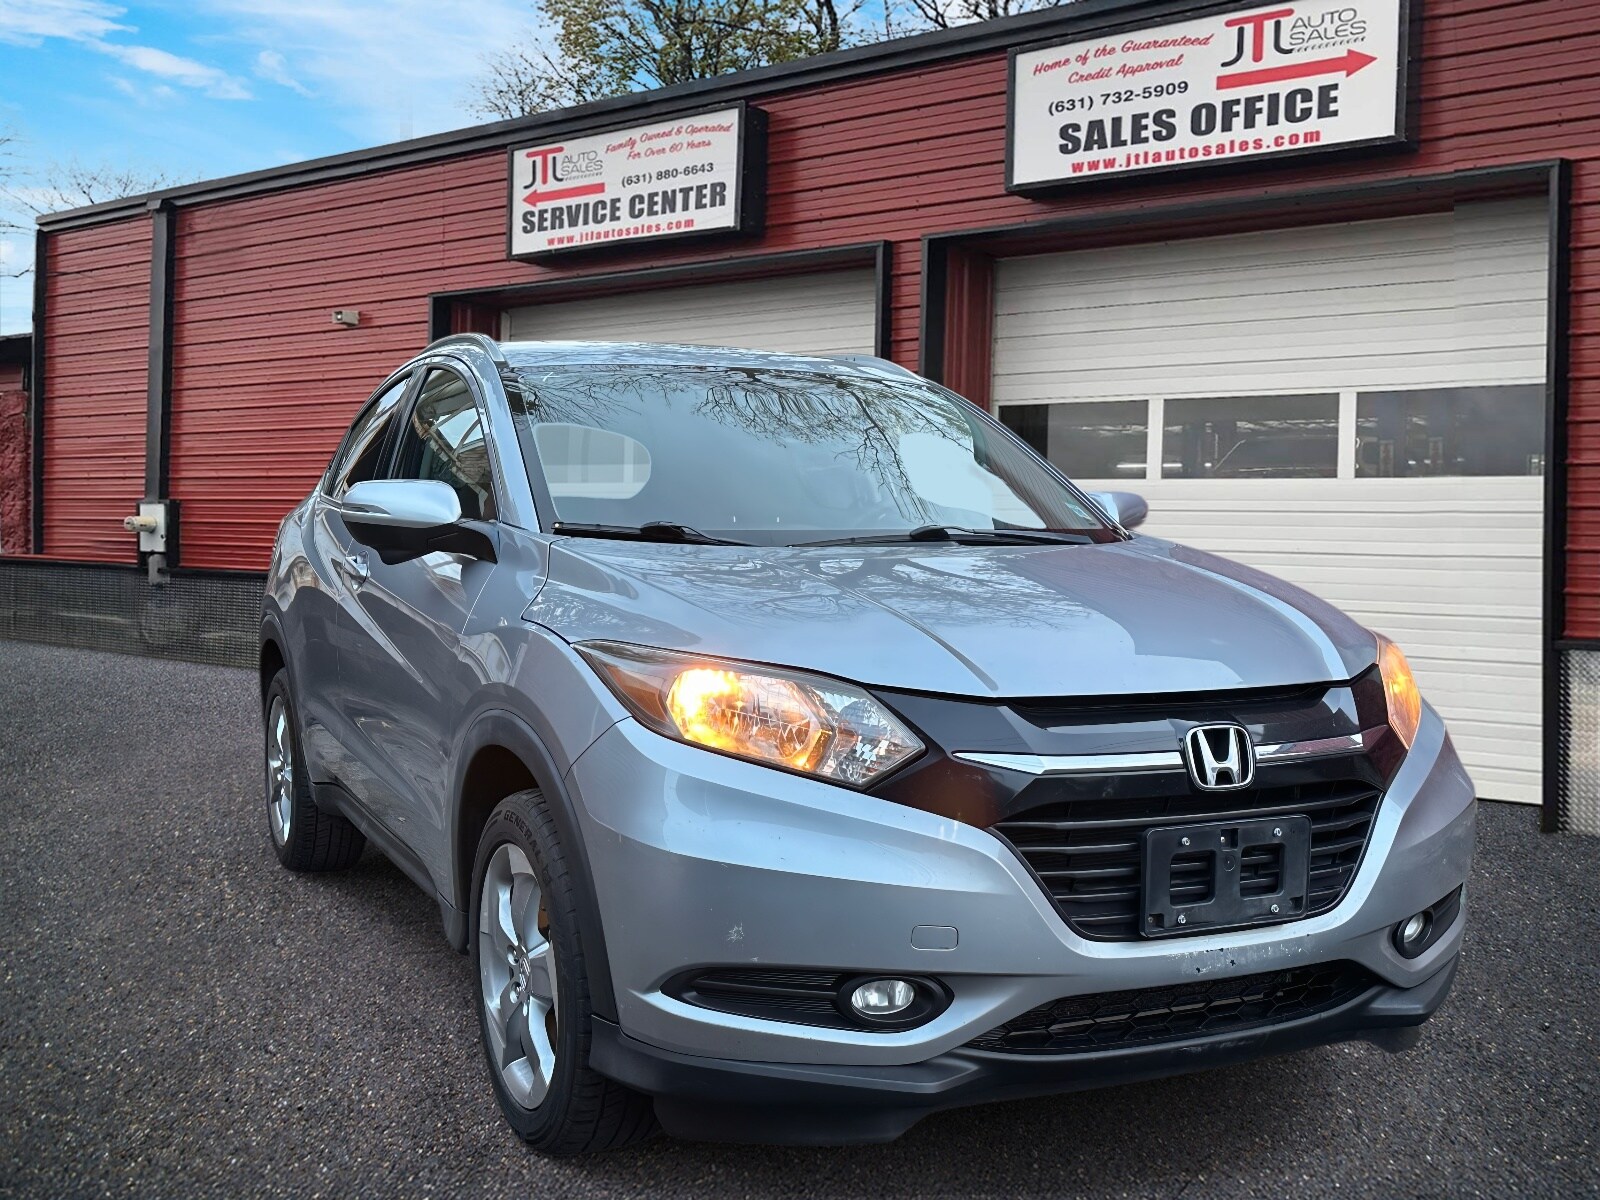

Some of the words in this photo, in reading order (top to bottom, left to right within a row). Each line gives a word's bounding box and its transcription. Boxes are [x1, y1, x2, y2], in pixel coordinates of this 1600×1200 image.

[1289, 20, 1367, 46] SALES
[1290, 7, 1358, 32] AUTO
[1033, 57, 1071, 76] Home
[1075, 49, 1090, 67] of
[1094, 45, 1117, 60] the
[1121, 33, 1214, 53] Guaranteed
[1067, 67, 1113, 85] Credit
[1116, 54, 1183, 79] Approval
[1047, 96, 1094, 117] (631)
[1100, 80, 1189, 106] 732-5909
[1058, 108, 1177, 155] SALES
[1190, 83, 1339, 137] OFFICE
[605, 138, 637, 154] Family
[640, 130, 673, 143] Owned
[675, 126, 683, 136] &
[685, 122, 734, 137] Operated
[627, 149, 641, 161] For
[644, 147, 667, 157] Over
[670, 142, 684, 153] 60
[686, 139, 712, 151] Years
[1071, 129, 1321, 174] www.jtlautosales.com
[560, 160, 604, 177] SALES
[561, 150, 598, 166] AUTO
[621, 173, 653, 188] (631)
[656, 162, 714, 181] 880-6643
[522, 197, 621, 234] SERVICE
[628, 181, 727, 219] CENTER
[547, 217, 695, 247] www.jtlautosales.com
